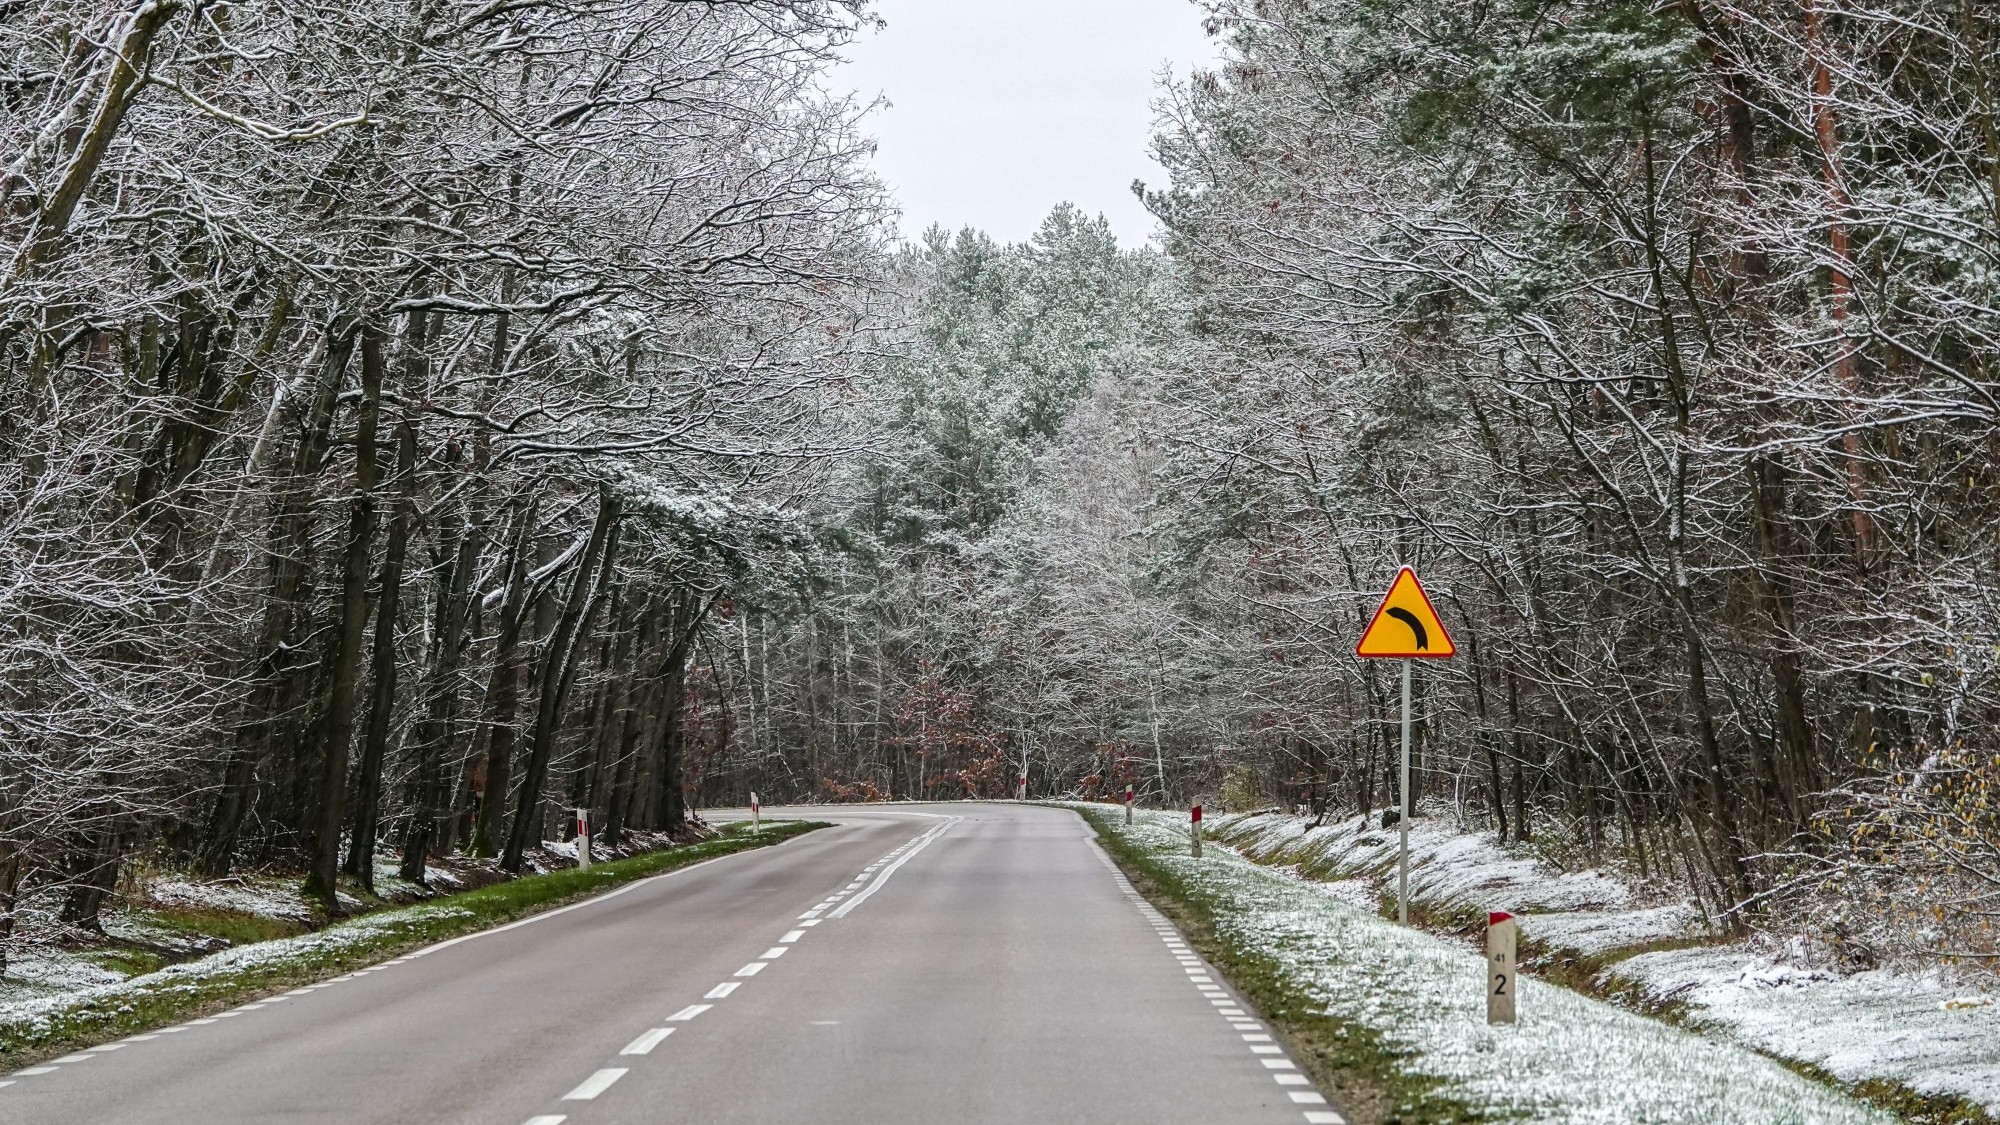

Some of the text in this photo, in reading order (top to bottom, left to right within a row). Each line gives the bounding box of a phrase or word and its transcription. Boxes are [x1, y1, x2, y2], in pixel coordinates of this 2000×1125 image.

[1194, 840, 1200, 848] 3
[1494, 953, 1505, 963] 41
[1494, 974, 1507, 995] 2
